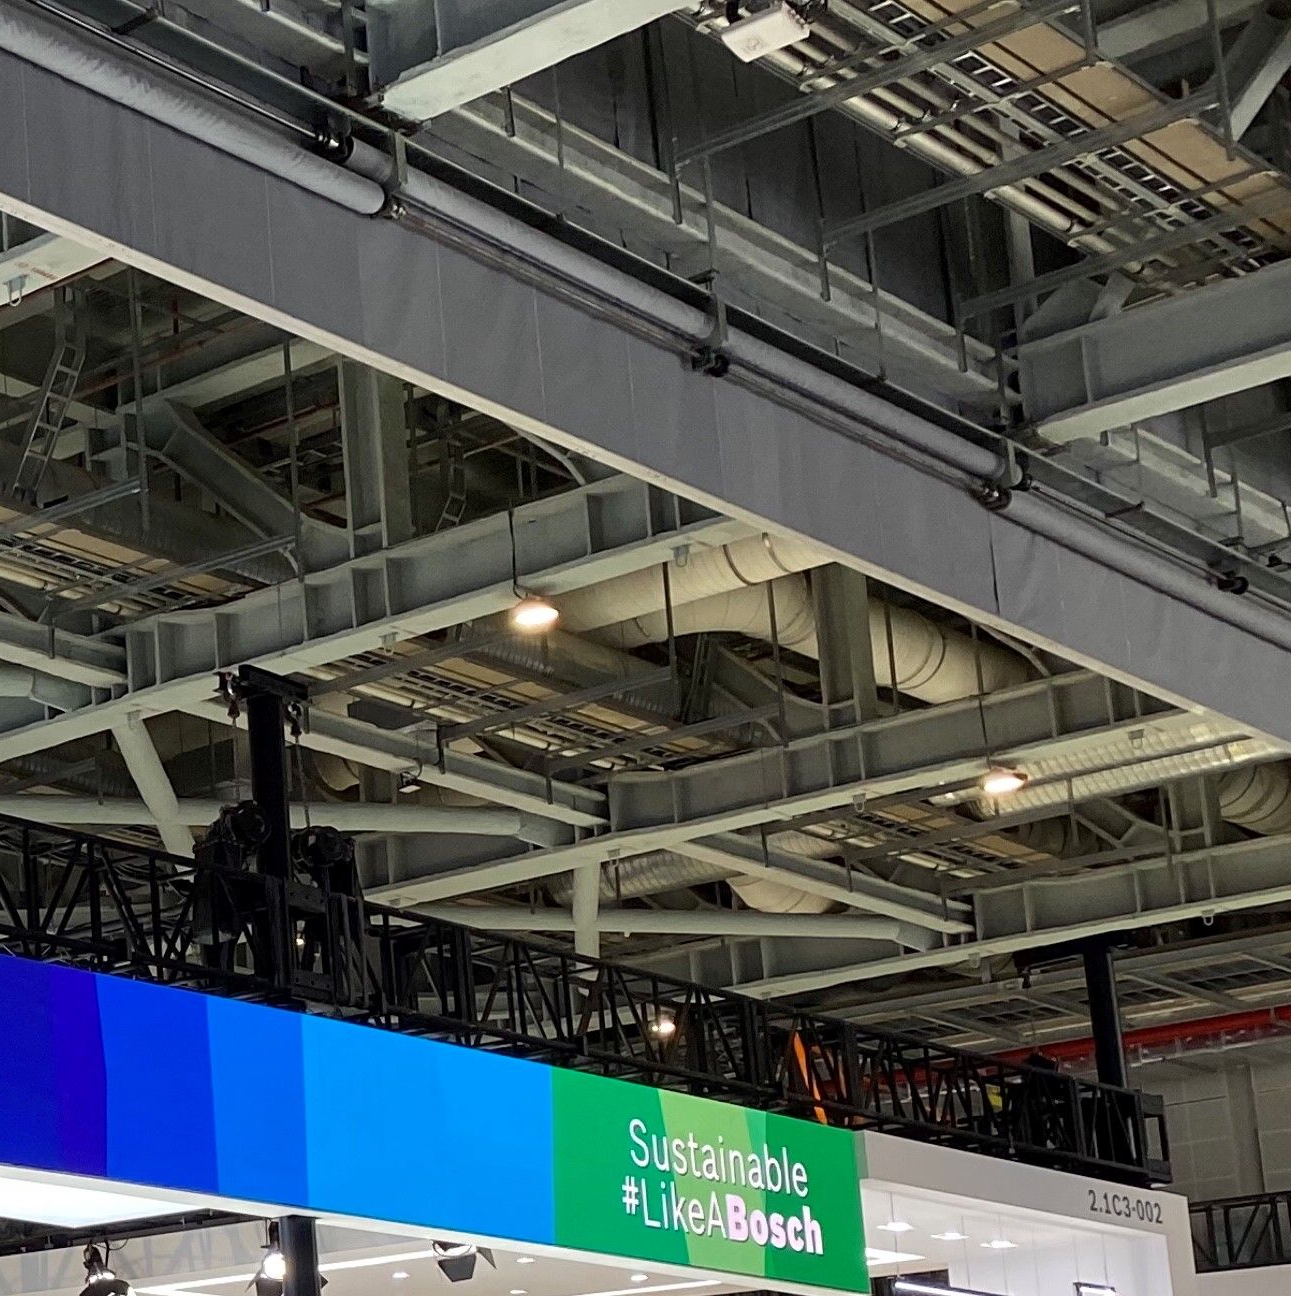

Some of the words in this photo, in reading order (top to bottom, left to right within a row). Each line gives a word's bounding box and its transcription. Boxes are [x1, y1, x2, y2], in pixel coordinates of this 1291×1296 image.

[629, 1118, 809, 1198] Sustainable
[621, 1175, 824, 1256] #LikeABosch
[1088, 1189, 1164, 1224] 2.1C3-002
